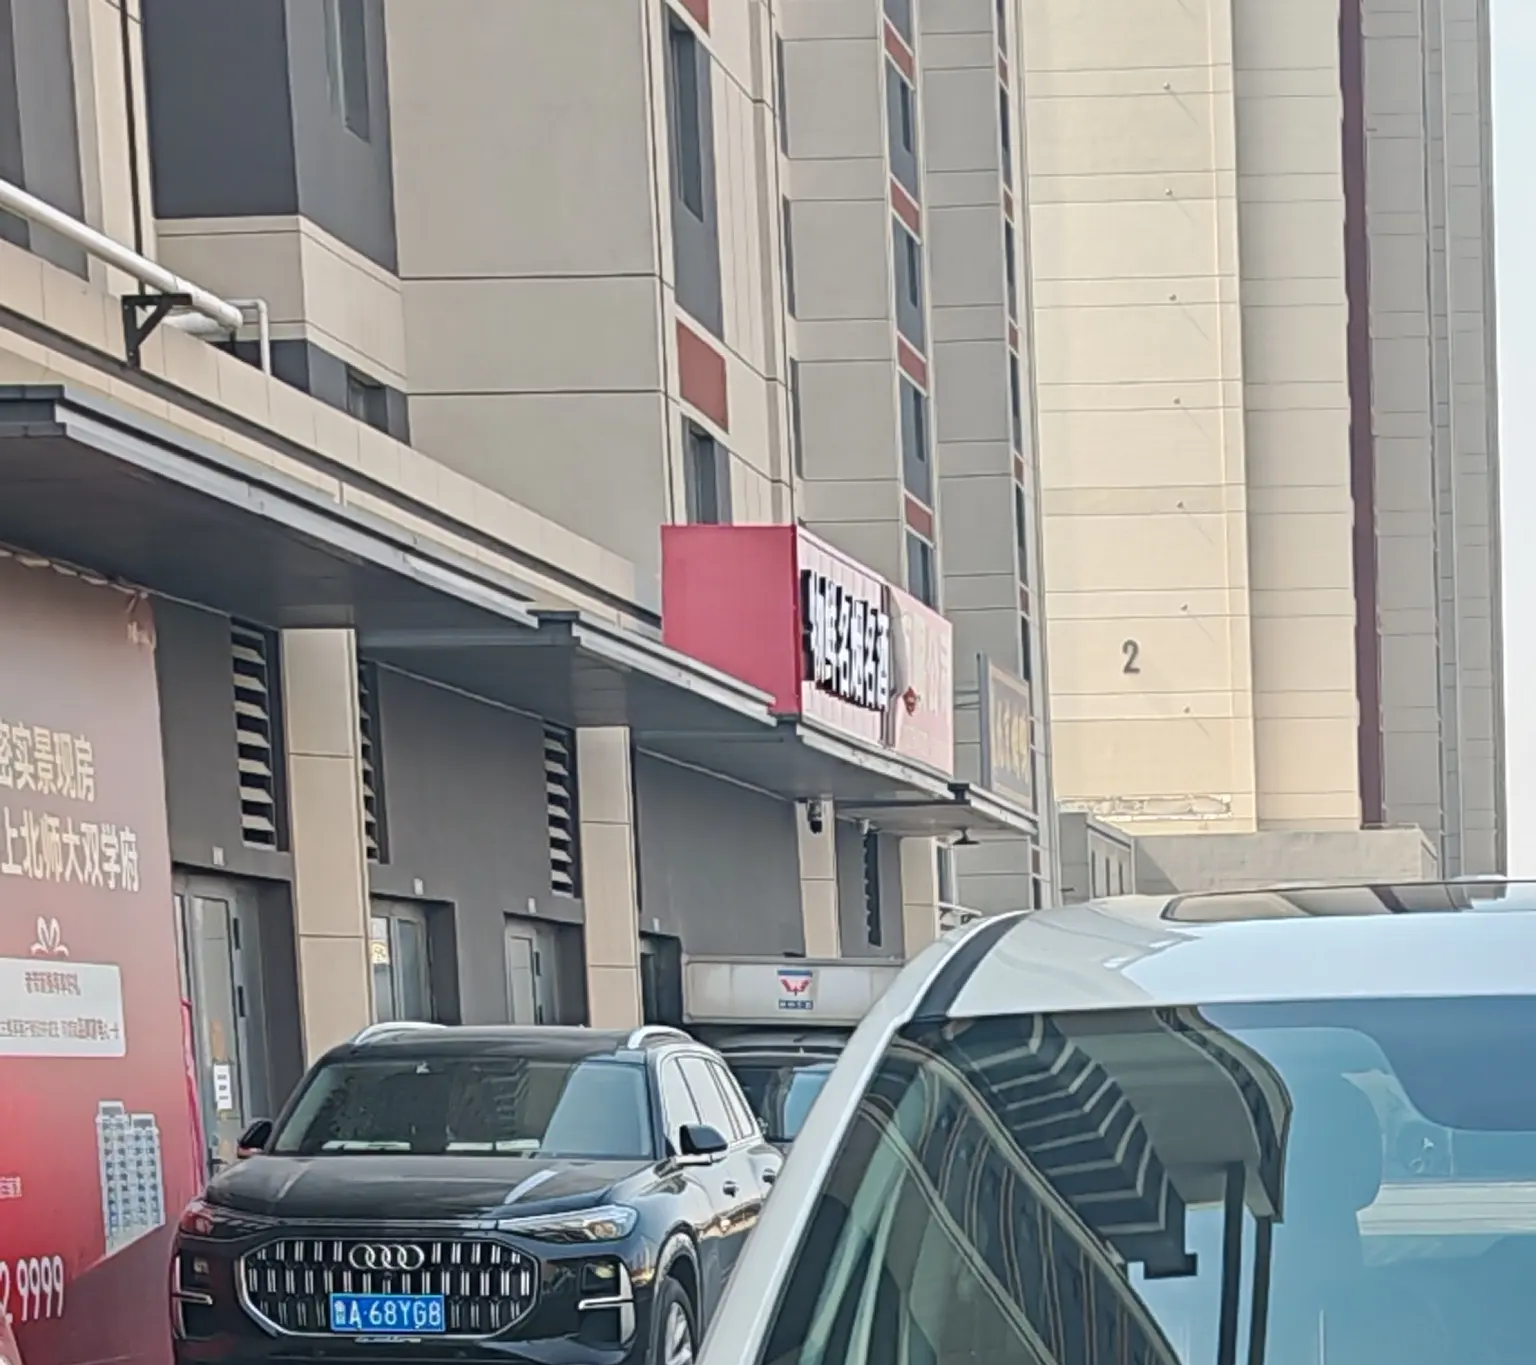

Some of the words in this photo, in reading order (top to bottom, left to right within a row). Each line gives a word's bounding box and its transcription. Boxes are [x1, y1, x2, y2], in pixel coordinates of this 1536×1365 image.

[1122, 638, 1141, 675] 2
[2, 806, 139, 892] 上北师大双学府
[16, 1255, 65, 1322] 9999
